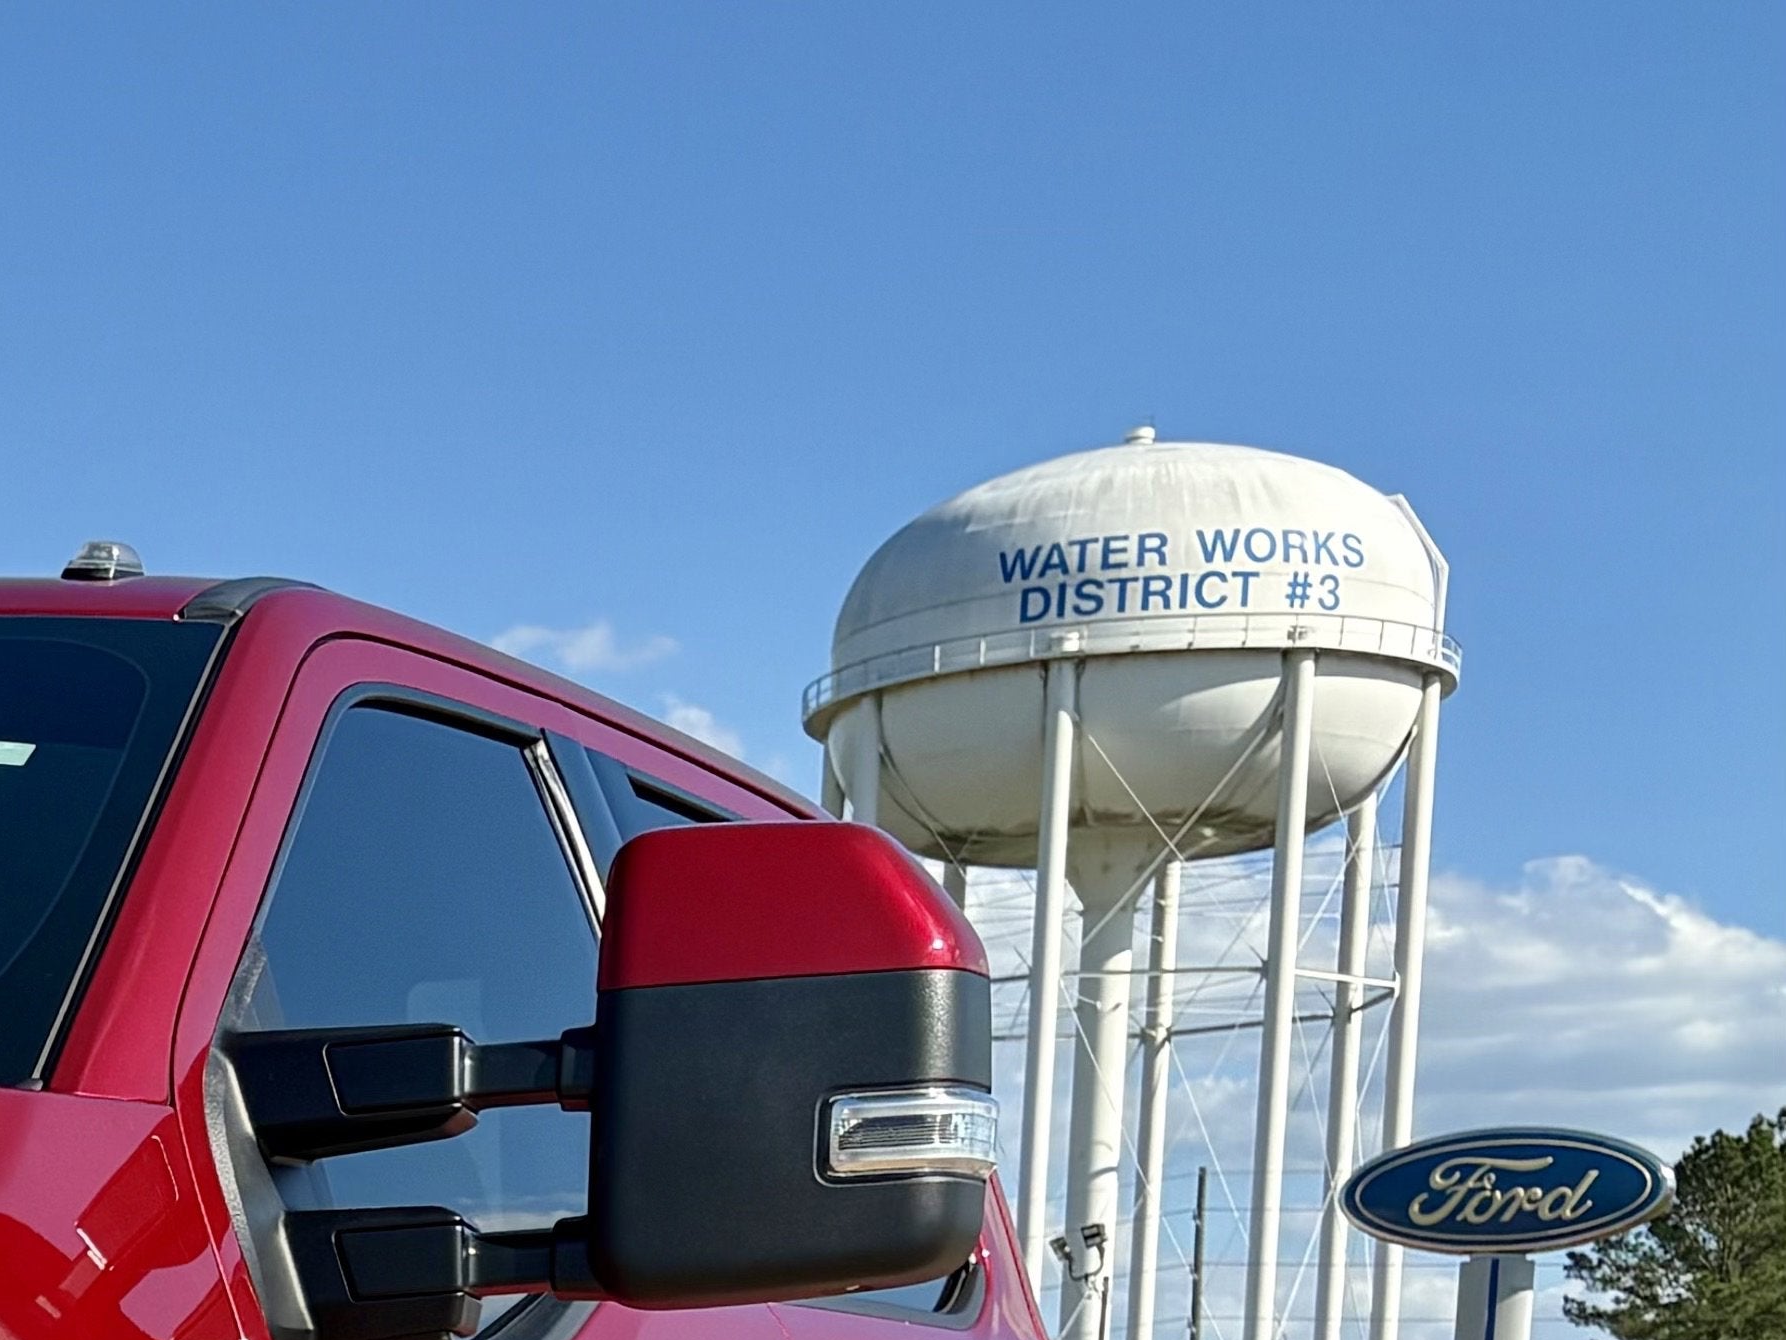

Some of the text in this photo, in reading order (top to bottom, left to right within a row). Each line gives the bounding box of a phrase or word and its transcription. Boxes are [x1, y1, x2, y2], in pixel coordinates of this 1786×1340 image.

[999, 528, 1365, 583] WATER WORKS
[1020, 570, 1341, 623] DISTRICT #3
[1408, 1156, 1599, 1226] Ford
